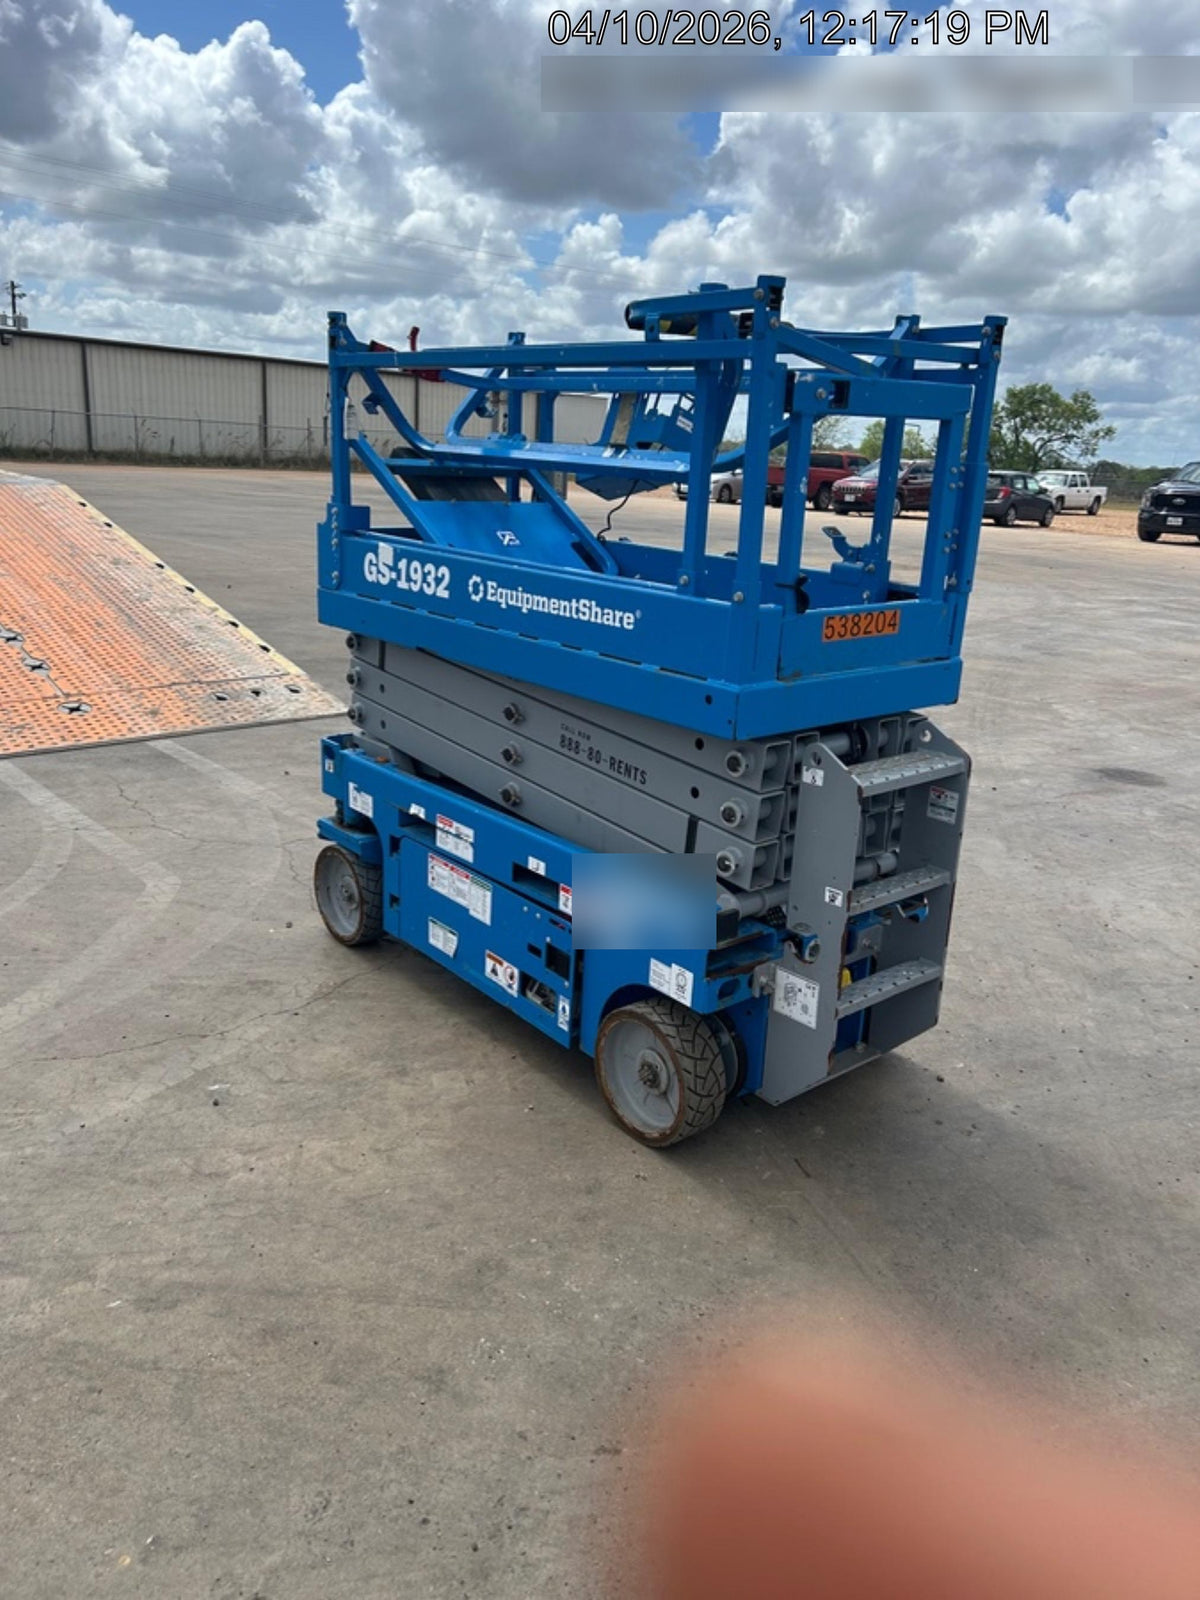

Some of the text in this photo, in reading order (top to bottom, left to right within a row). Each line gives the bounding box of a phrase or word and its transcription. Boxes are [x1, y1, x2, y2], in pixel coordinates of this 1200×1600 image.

[363, 551, 451, 599] GS-1932
[824, 610, 897, 640] 538204
[560, 734, 648, 785] 888-80-RENTS
